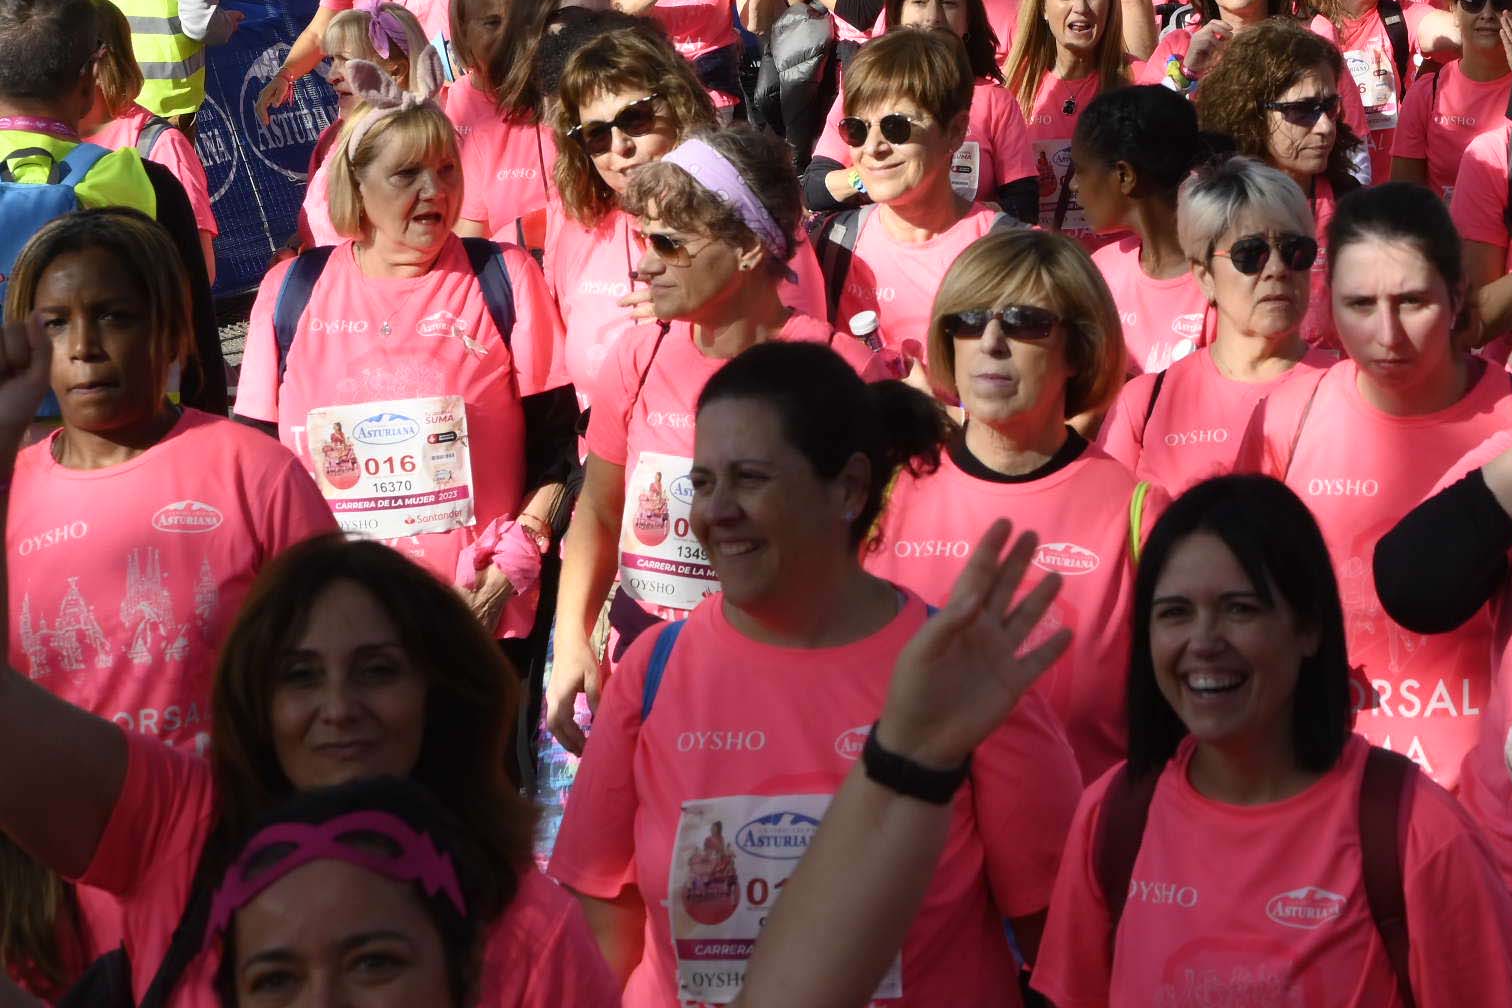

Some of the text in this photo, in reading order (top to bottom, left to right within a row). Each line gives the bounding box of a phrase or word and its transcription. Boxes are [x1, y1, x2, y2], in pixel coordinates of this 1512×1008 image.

[424, 415, 455, 424] SUMA
[358, 423, 416, 440] ASTURIANA
[1164, 427, 1228, 447] OYSHO
[364, 454, 417, 476] 016
[372, 480, 412, 493] 16370
[1308, 480, 1378, 497] OYSHO
[336, 490, 458, 510] CARRERA DE LA MUJER 2023
[159, 513, 218, 527] ASTURIANA
[416, 509, 463, 524] Santander
[19, 520, 88, 557] OYSHO
[894, 540, 970, 558] OYSHO
[636, 558, 676, 572] CARRERA
[678, 565, 690, 575] DE
[693, 568, 704, 577] LA
[1037, 550, 1095, 570] ASTURIANA
[630, 577, 675, 596] OYSHO
[677, 729, 766, 753] OYSHO
